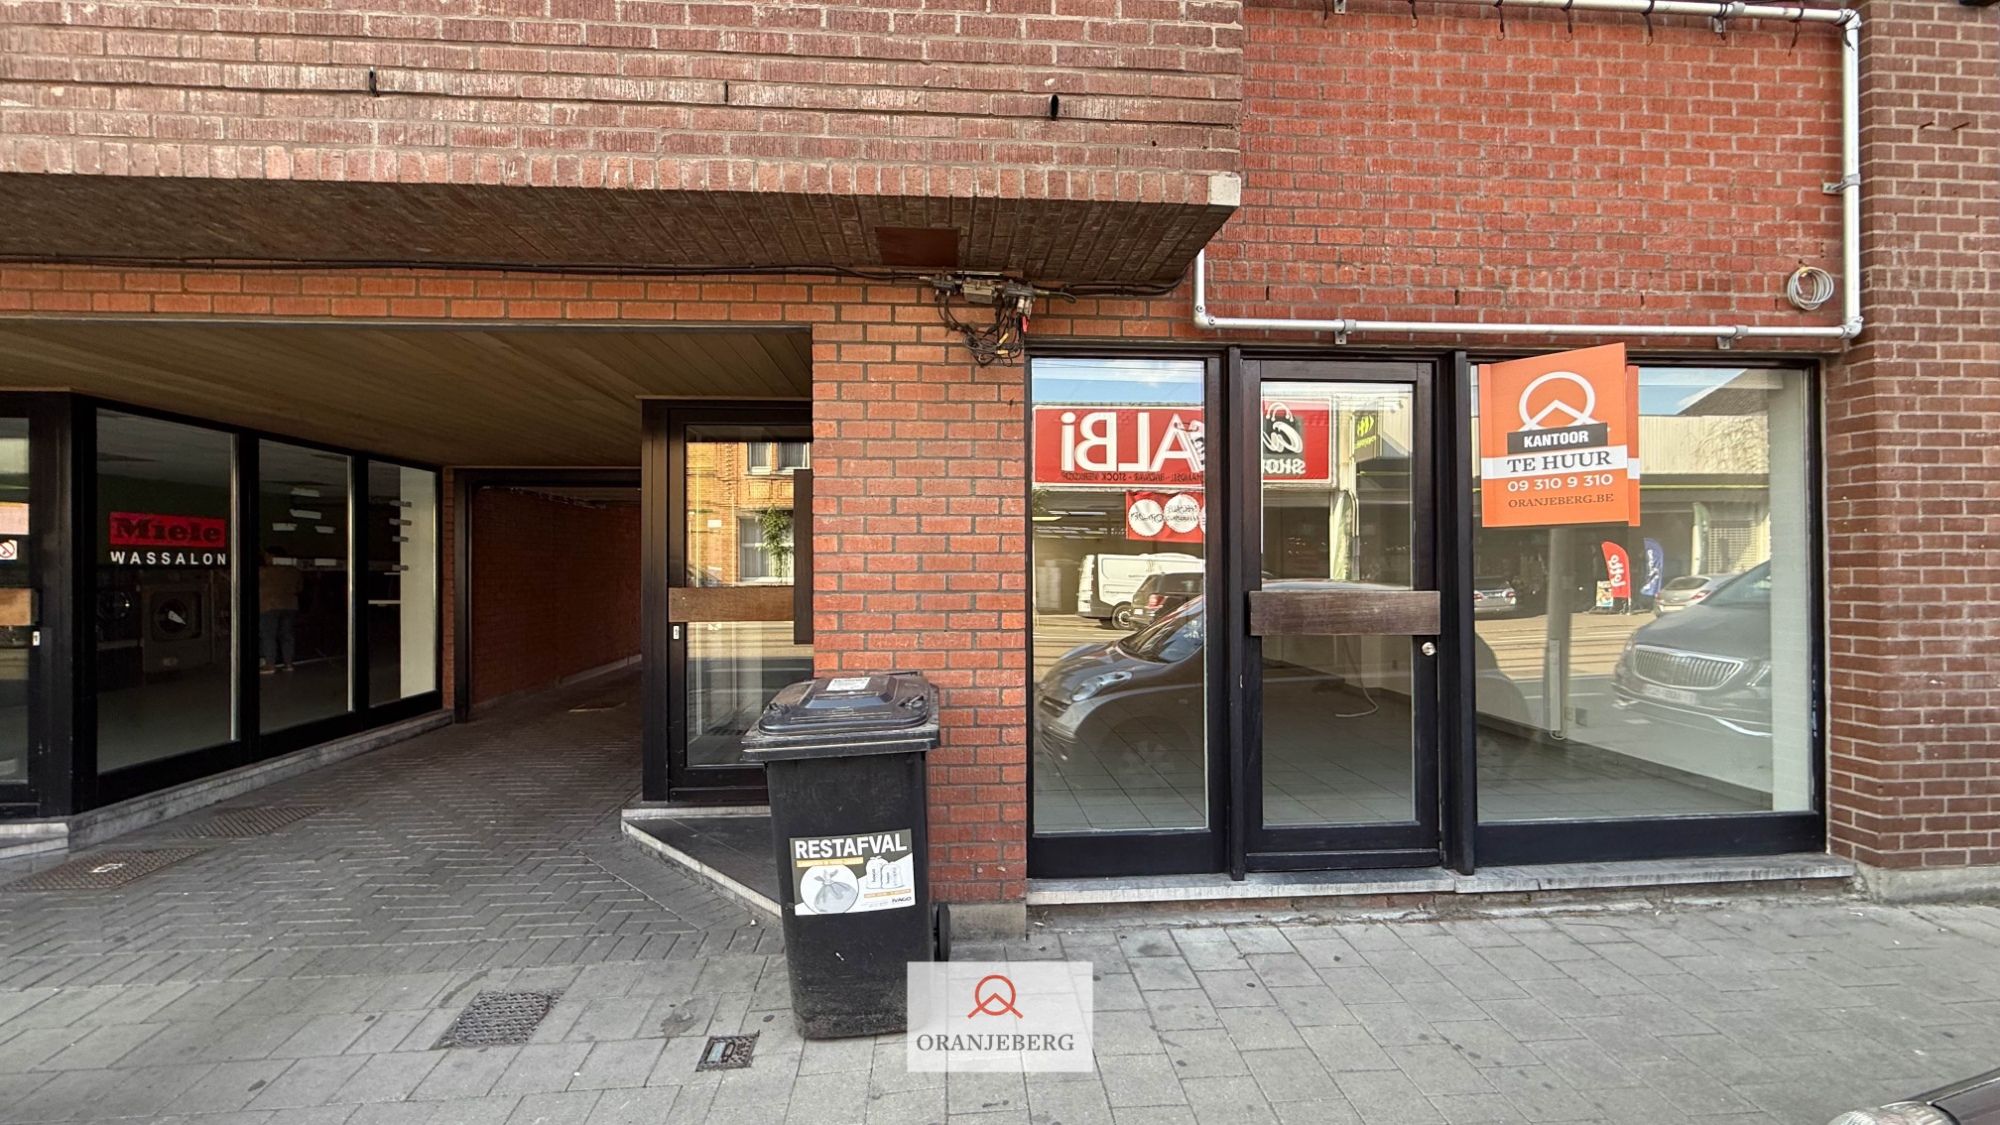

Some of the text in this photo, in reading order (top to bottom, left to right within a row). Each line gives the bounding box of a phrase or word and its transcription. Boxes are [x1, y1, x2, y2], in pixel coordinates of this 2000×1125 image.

[1524, 430, 1589, 448] KANTOOR
[1507, 451, 1611, 473] TE HUUR
[1507, 473, 1614, 492] 09 310 9 310
[1508, 493, 1614, 508] ORANJEBERG.BE
[114, 517, 221, 543] Miele
[110, 551, 226, 565] WASSALON
[794, 832, 908, 859] RESTAFVAL
